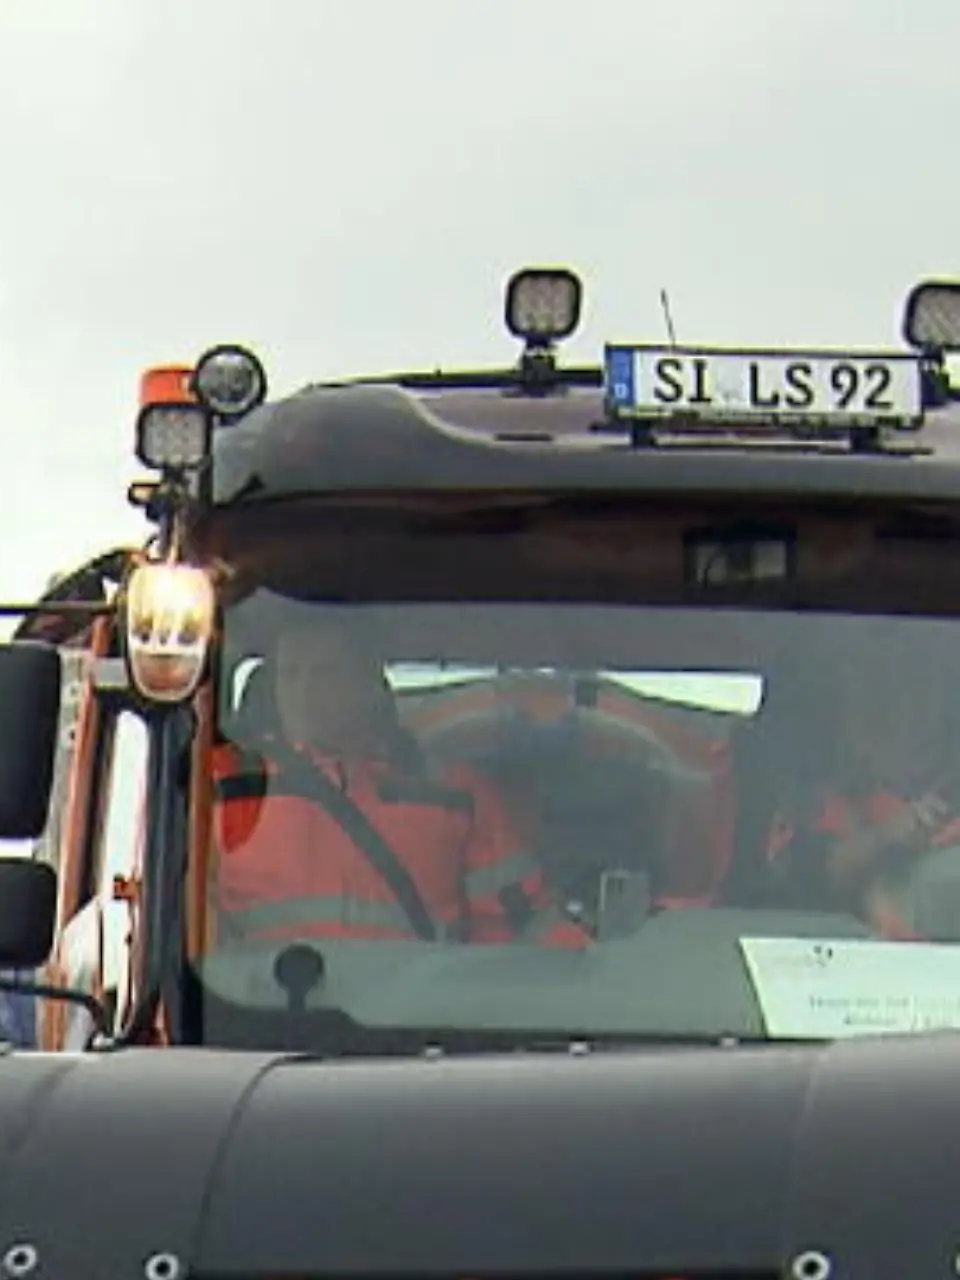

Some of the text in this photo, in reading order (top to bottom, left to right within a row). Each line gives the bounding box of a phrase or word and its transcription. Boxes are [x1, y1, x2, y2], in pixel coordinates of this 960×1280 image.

[654, 358, 712, 403] SI
[750, 362, 815, 408] LS
[831, 363, 894, 409] 92
